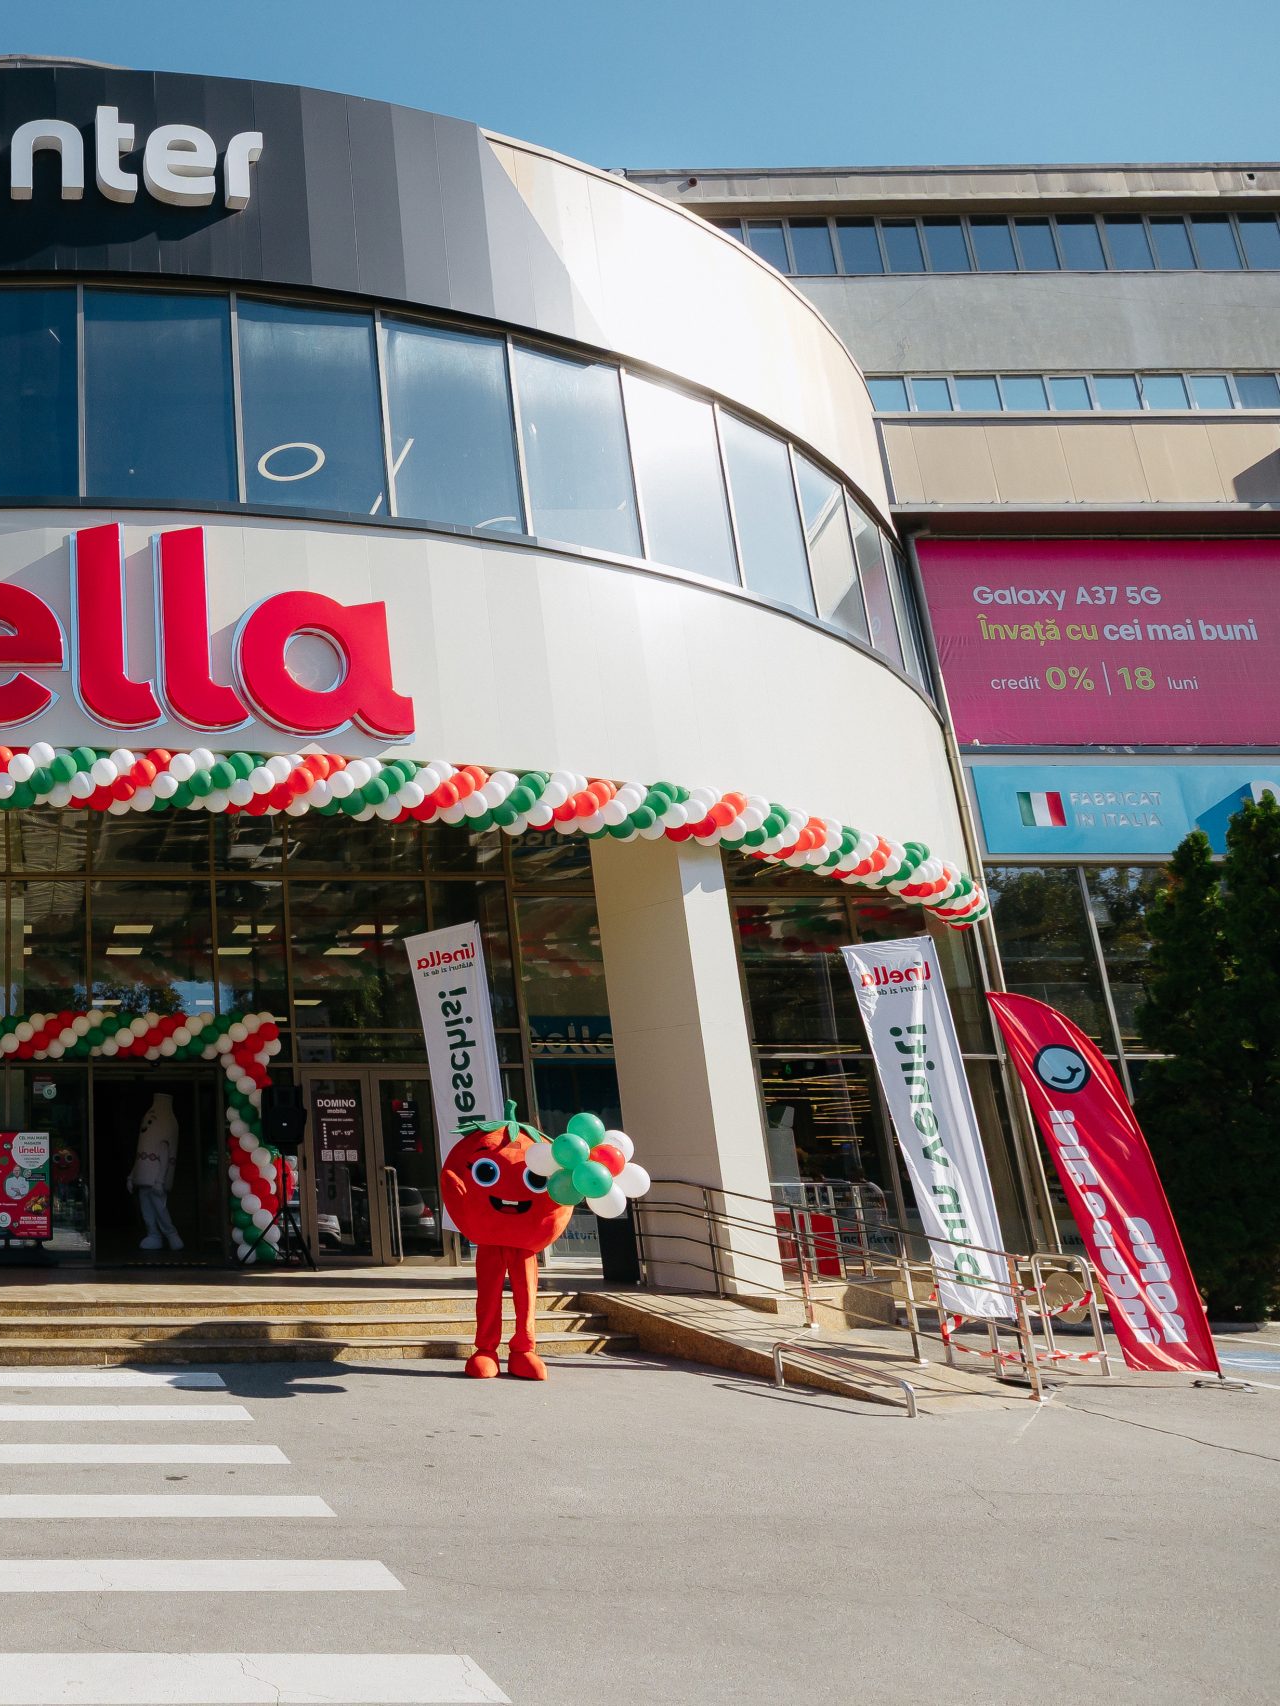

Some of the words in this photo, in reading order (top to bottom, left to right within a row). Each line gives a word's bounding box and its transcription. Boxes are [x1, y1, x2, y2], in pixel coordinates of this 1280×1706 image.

[973, 586, 1066, 610] Galaxy
[1076, 586, 1118, 605] A37
[1126, 586, 1162, 605] 5G
[976, 614, 1061, 646] Învață
[1066, 624, 1098, 641] cu
[1103, 619, 1140, 641] cei
[1147, 619, 1195, 641] mai
[1200, 619, 1258, 641] buni
[990, 676, 1040, 690] credit
[1045, 667, 1095, 691] 0%
[1118, 667, 1156, 691] 18
[1168, 676, 1198, 690] luni
[1070, 791, 1161, 805] FABRICAT
[1077, 812, 1096, 826] IN
[1102, 812, 1163, 826] ITALIA
[317, 1099, 356, 1107] DOMINO
[18, 1146, 45, 1154] linella
